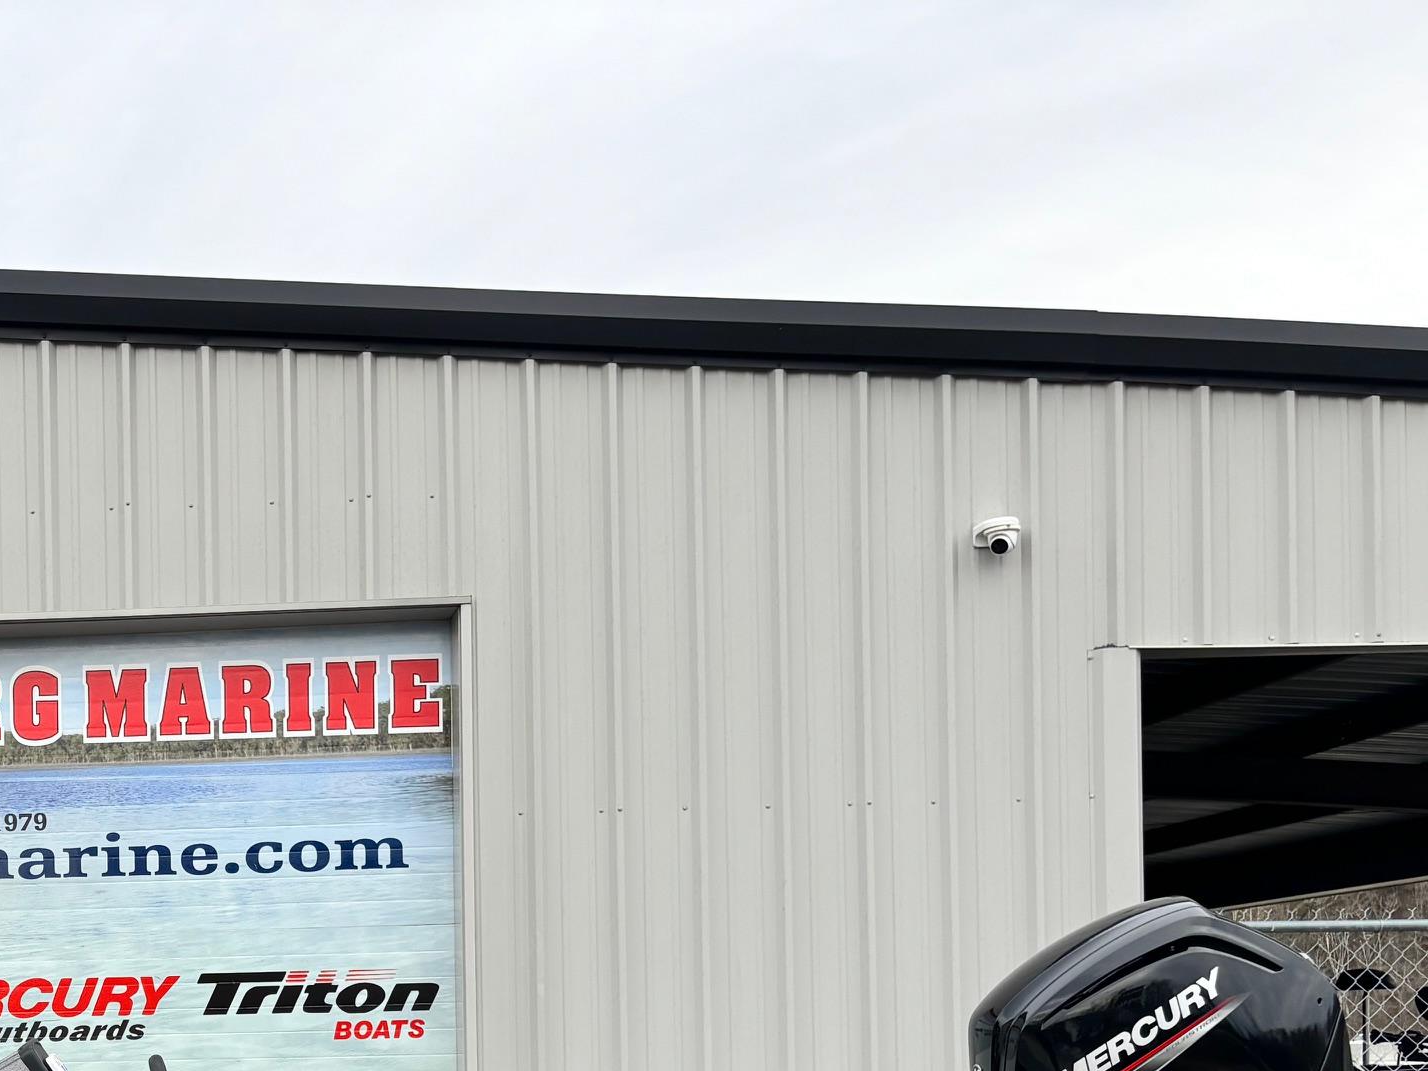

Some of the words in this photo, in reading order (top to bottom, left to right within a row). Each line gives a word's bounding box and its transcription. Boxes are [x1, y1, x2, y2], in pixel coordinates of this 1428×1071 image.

[83, 654, 443, 744] MARINE
[197, 970, 440, 1015] Triton
[334, 1019, 425, 1041] BOATS
